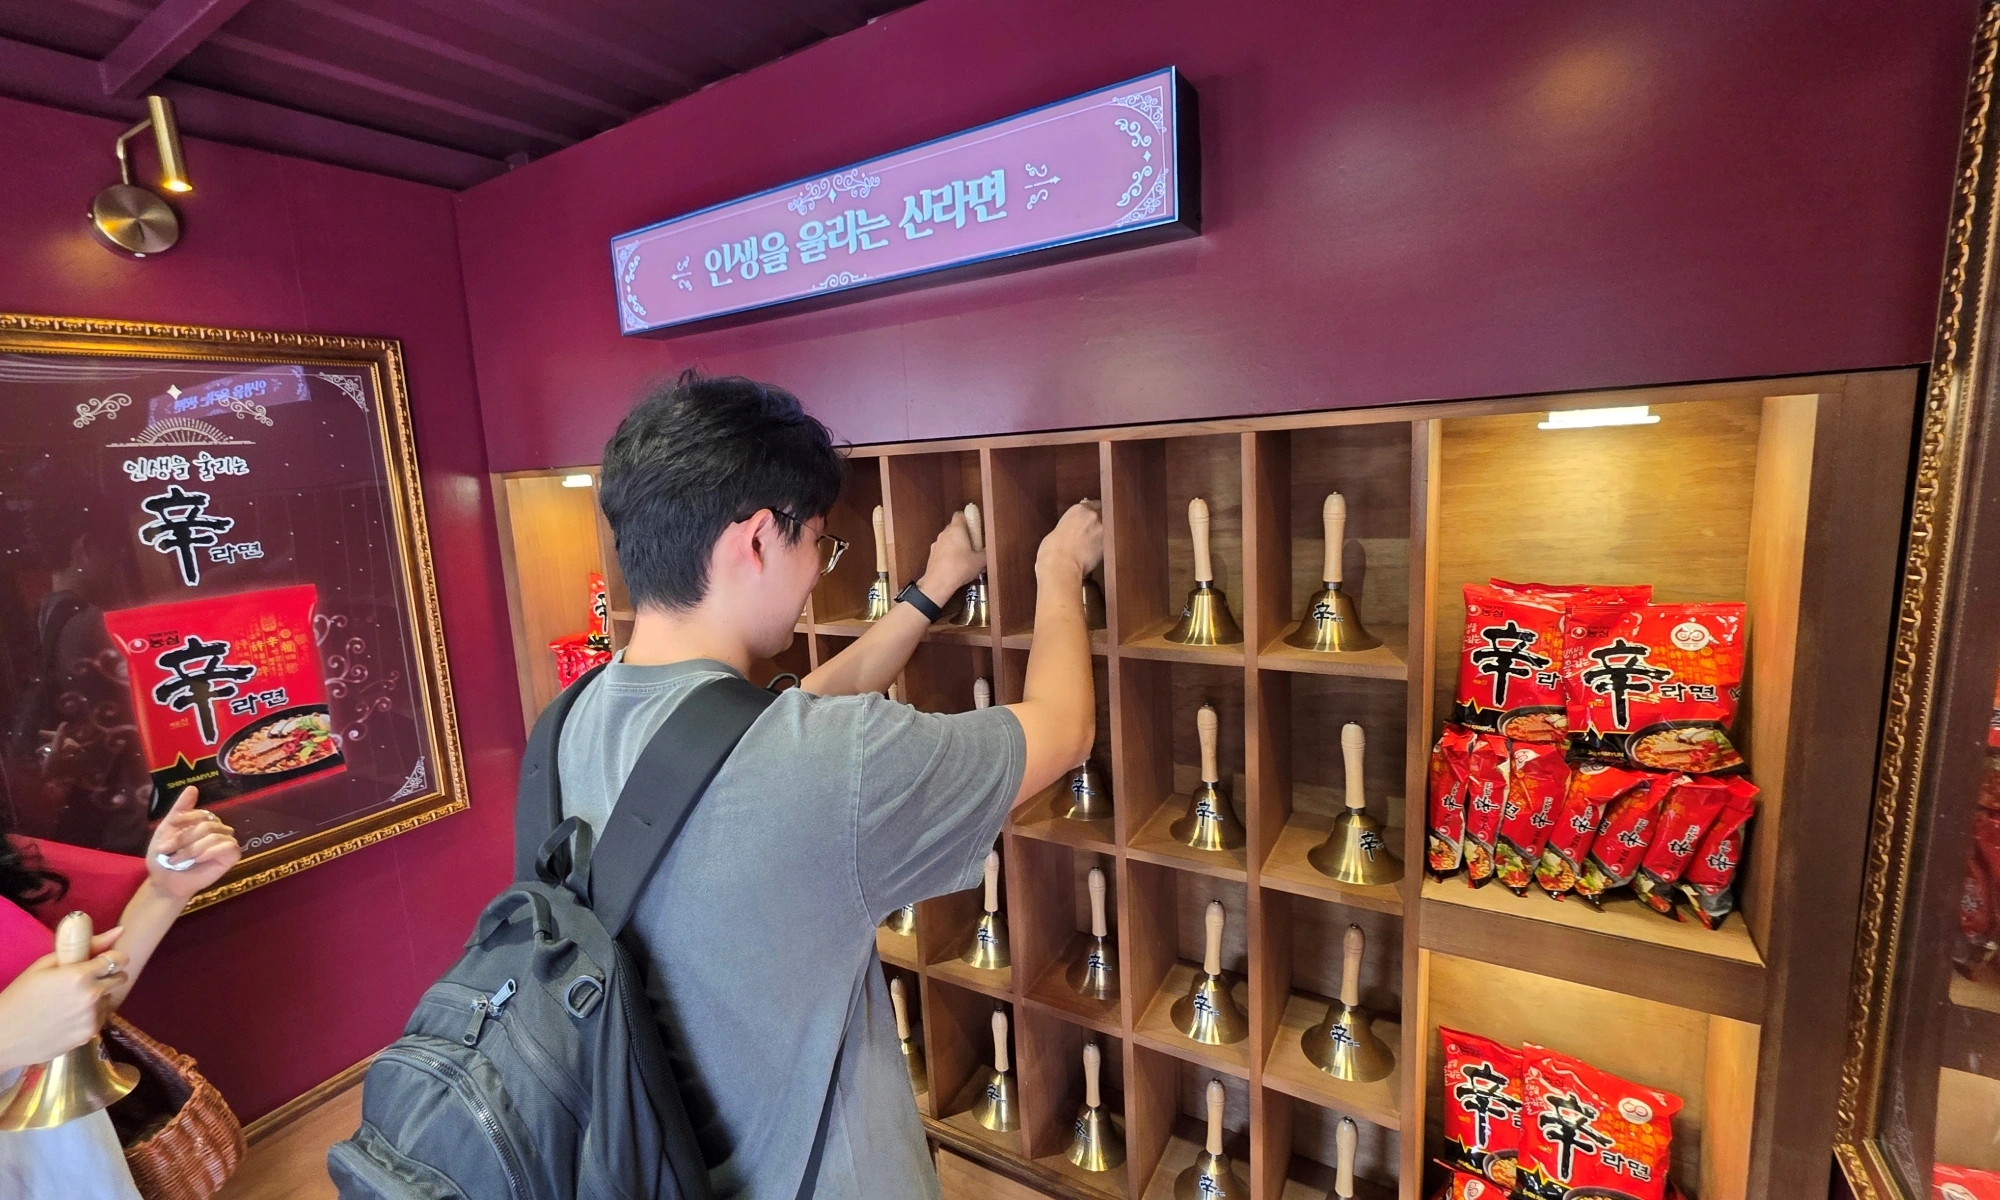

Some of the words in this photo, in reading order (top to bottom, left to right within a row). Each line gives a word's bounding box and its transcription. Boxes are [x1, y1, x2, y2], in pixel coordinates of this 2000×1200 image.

[705, 231, 789, 287] 인생을
[796, 209, 890, 264] 울리는
[899, 169, 1006, 238] 신라면
[123, 456, 190, 482] 인생을
[194, 451, 249, 482] 울리는
[149, 635, 180, 648] 농심
[1537, 672, 1561, 690] 라
